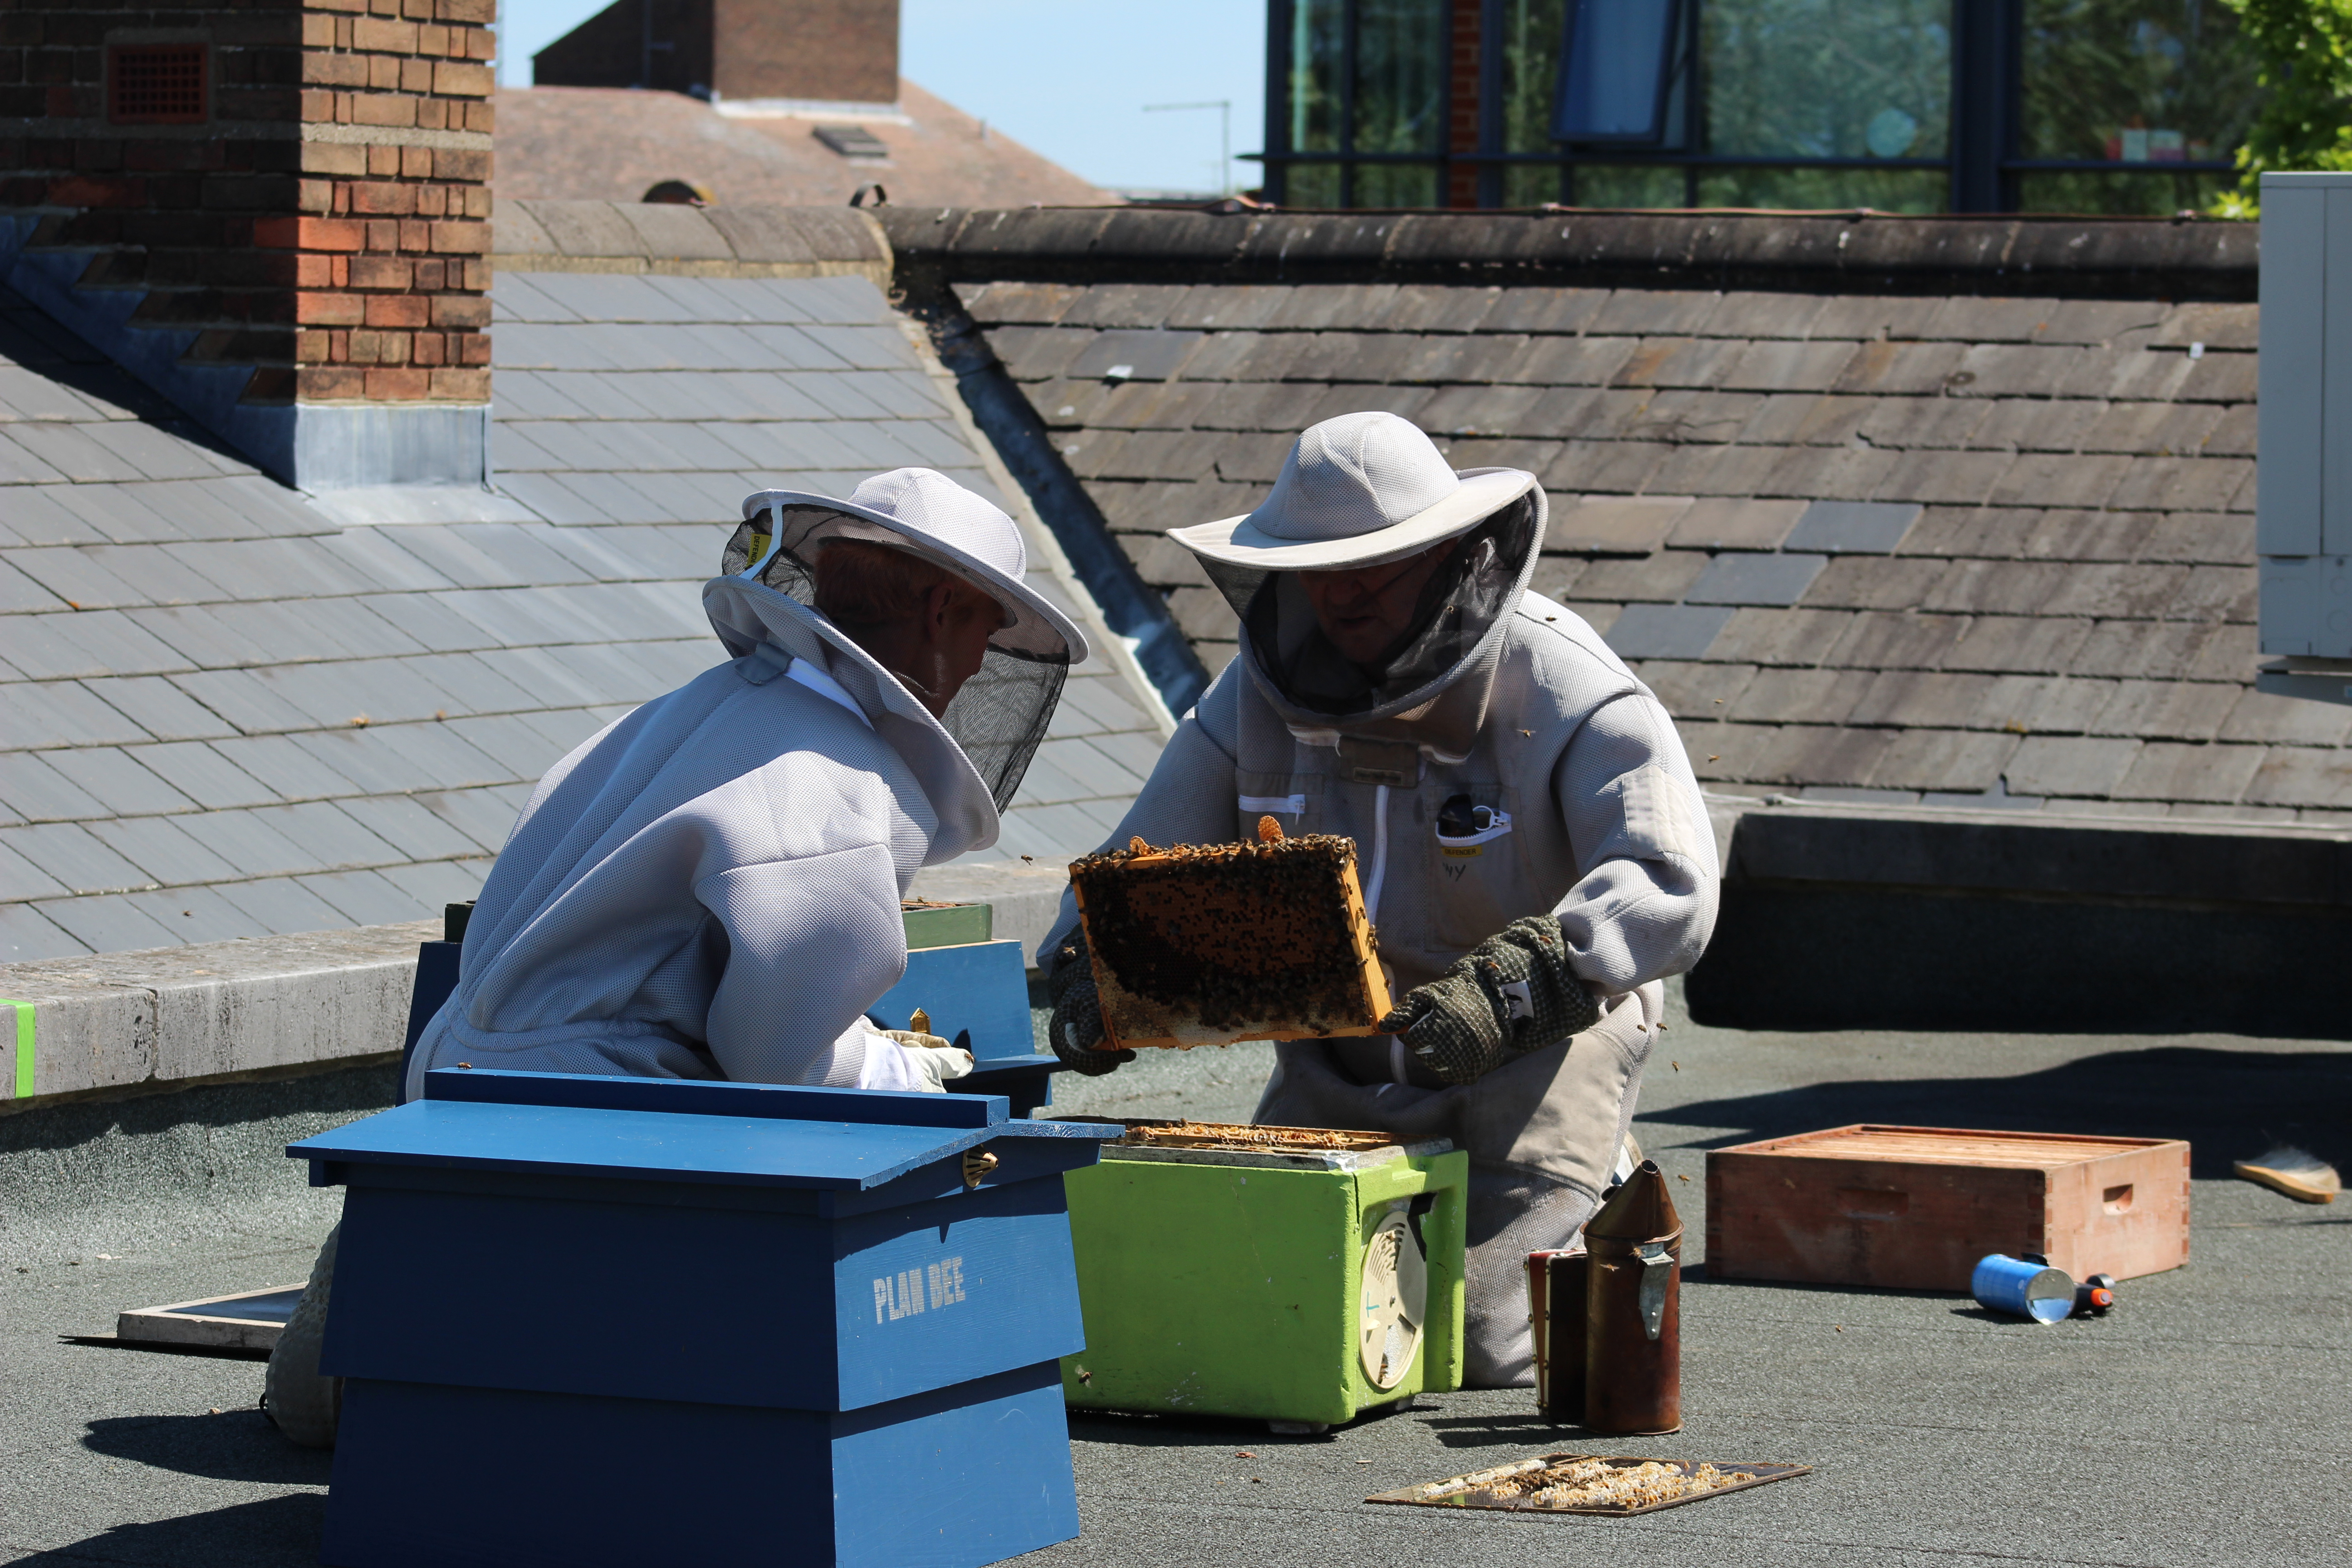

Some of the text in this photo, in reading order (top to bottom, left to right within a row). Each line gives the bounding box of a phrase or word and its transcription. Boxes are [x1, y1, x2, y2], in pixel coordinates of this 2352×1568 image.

[750, 536, 760, 564] DEFENDE
[873, 1256, 965, 1324] PLAN BEE
